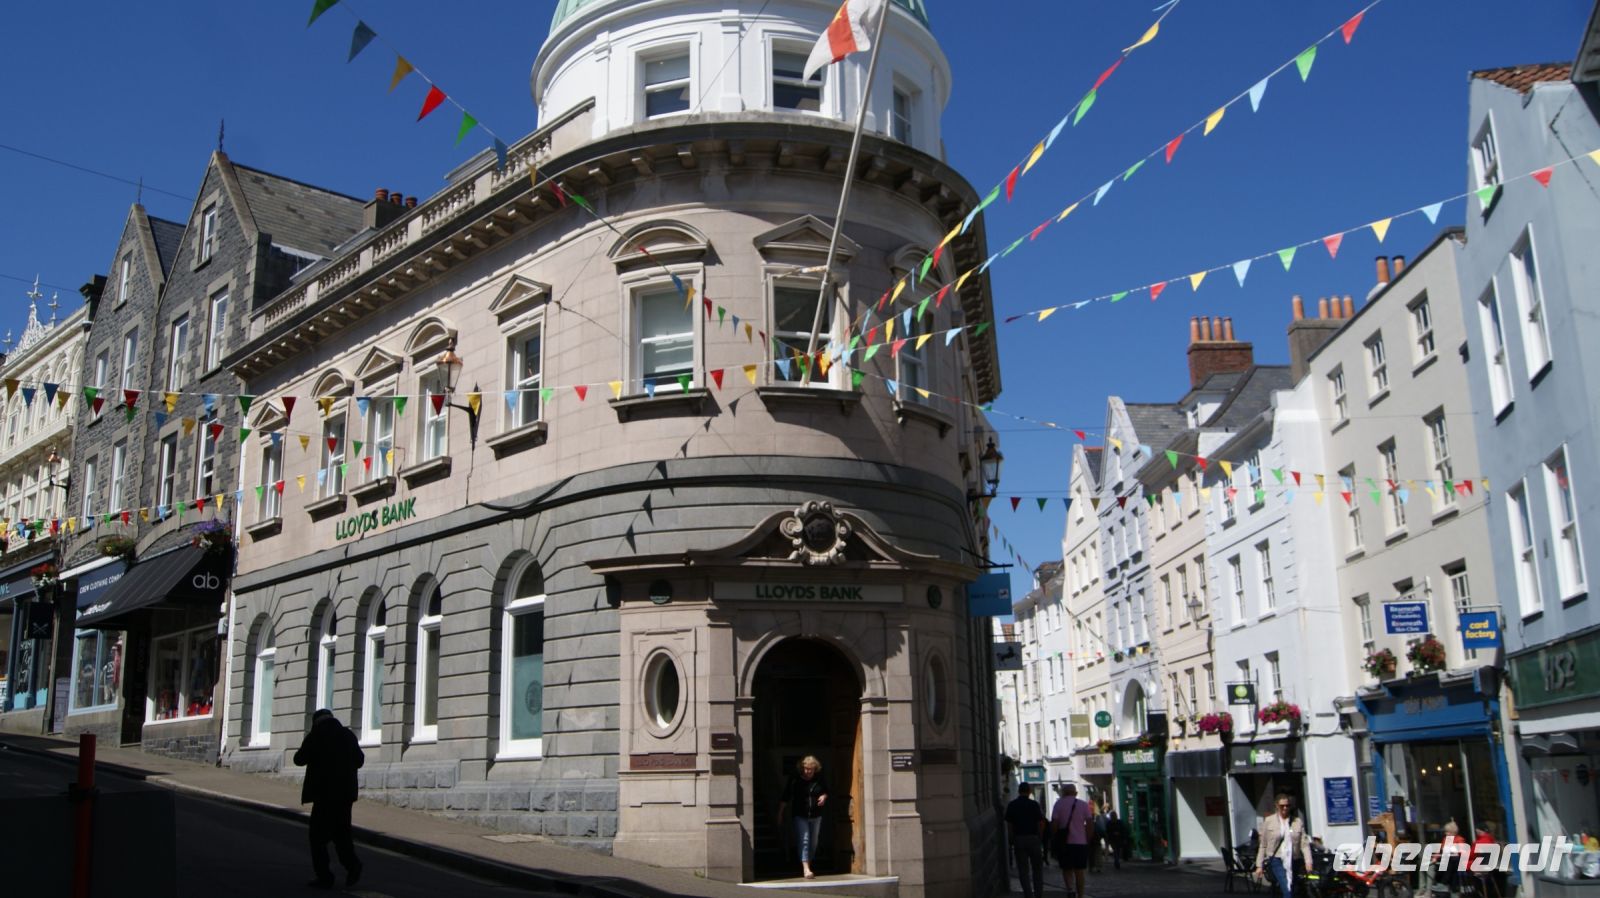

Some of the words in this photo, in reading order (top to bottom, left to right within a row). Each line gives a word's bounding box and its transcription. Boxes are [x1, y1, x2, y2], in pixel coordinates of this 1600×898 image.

[335, 508, 379, 541] LLOYDS
[381, 496, 417, 527] BANK
[192, 571, 220, 590] ab
[756, 584, 816, 599] LLOYDS
[819, 585, 863, 600] BANK
[1469, 619, 1489, 629] card
[1465, 629, 1496, 639] factory
